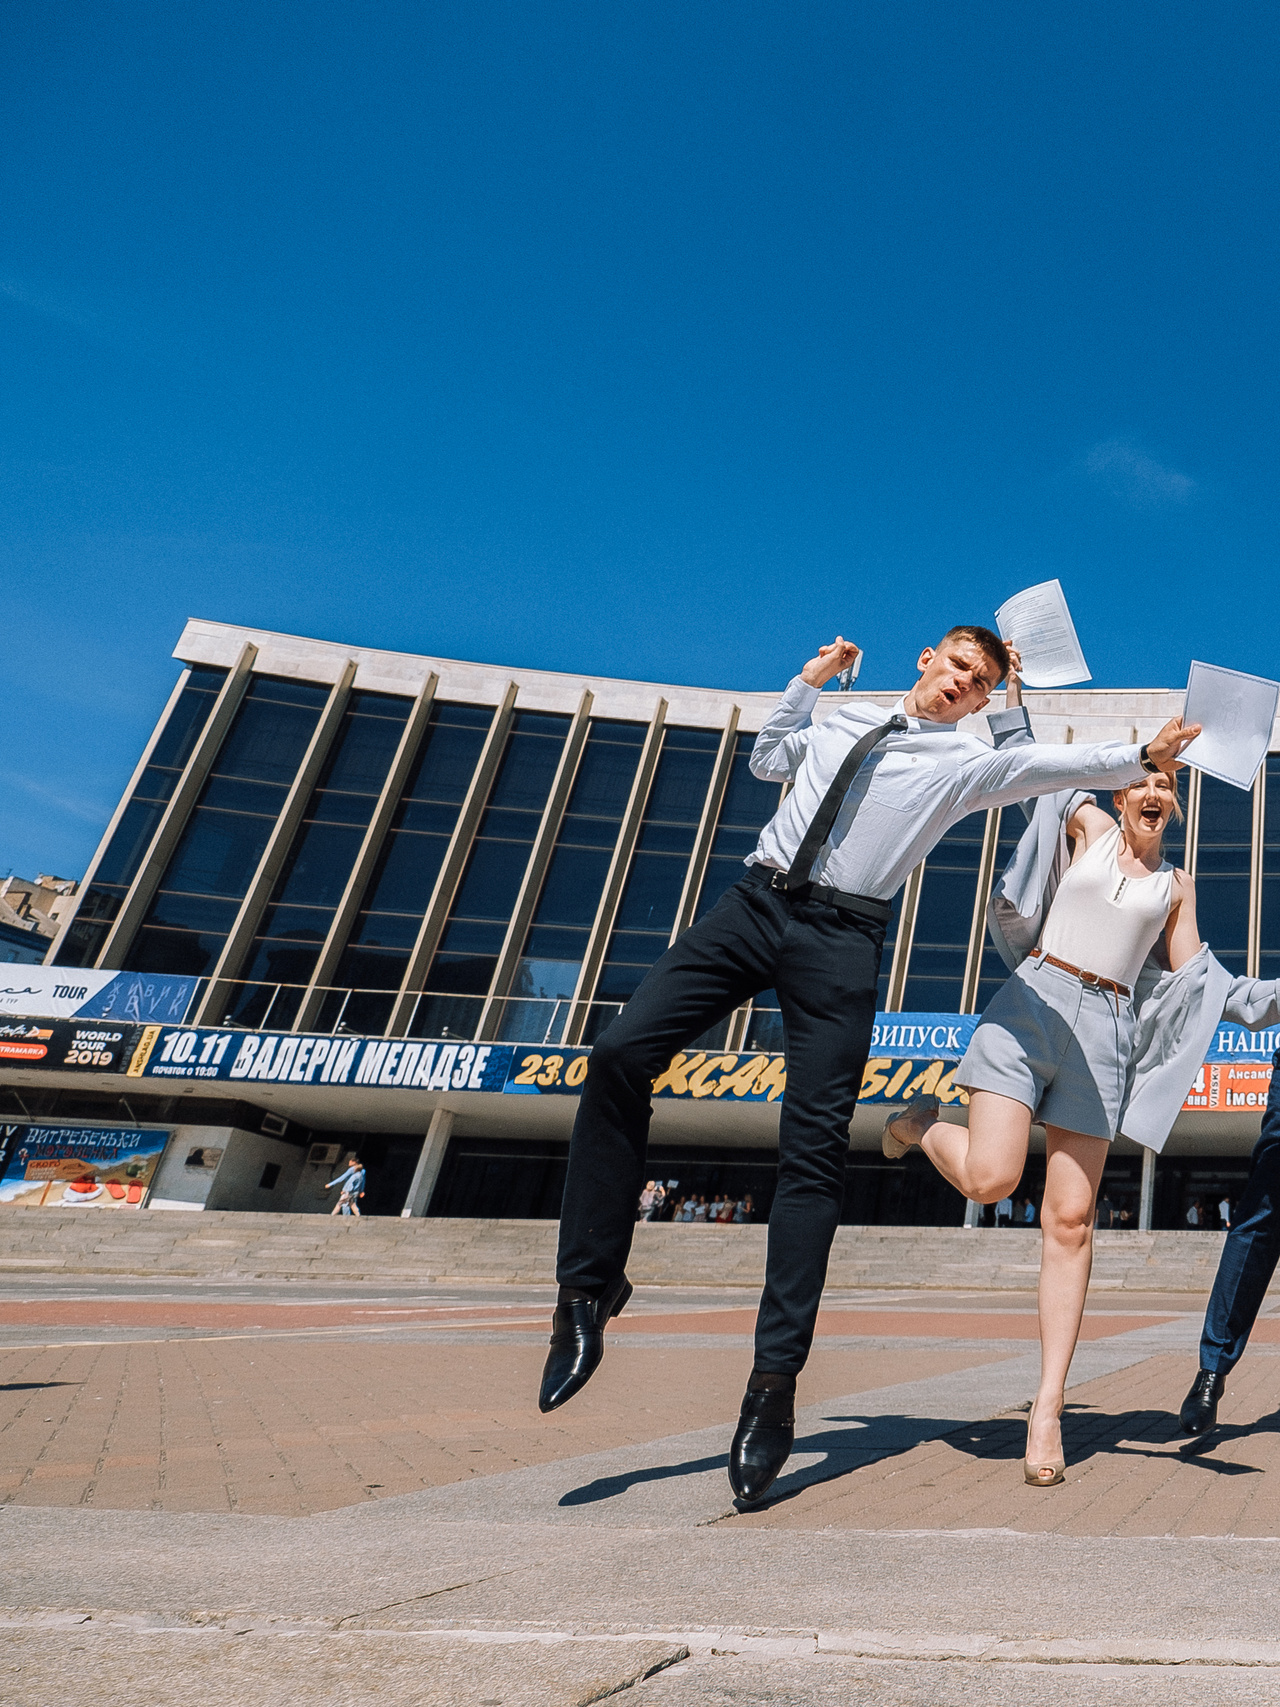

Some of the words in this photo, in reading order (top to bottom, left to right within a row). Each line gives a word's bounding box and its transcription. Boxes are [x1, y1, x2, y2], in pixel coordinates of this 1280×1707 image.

[52, 985, 88, 1000] TOUR
[76, 1030, 123, 1042] WORLD
[71, 1041, 106, 1051] TOUR
[64, 1051, 113, 1066] 2019
[160, 1032, 232, 1064] 10.11
[230, 1035, 360, 1083] ВАЛЕРІЙ
[354, 1041, 492, 1092] МЕЛАДЗЕ
[1210, 1066, 1219, 1107] VIRSKY
[25, 1127, 142, 1149] ВИТРЕБЕНЬКИ
